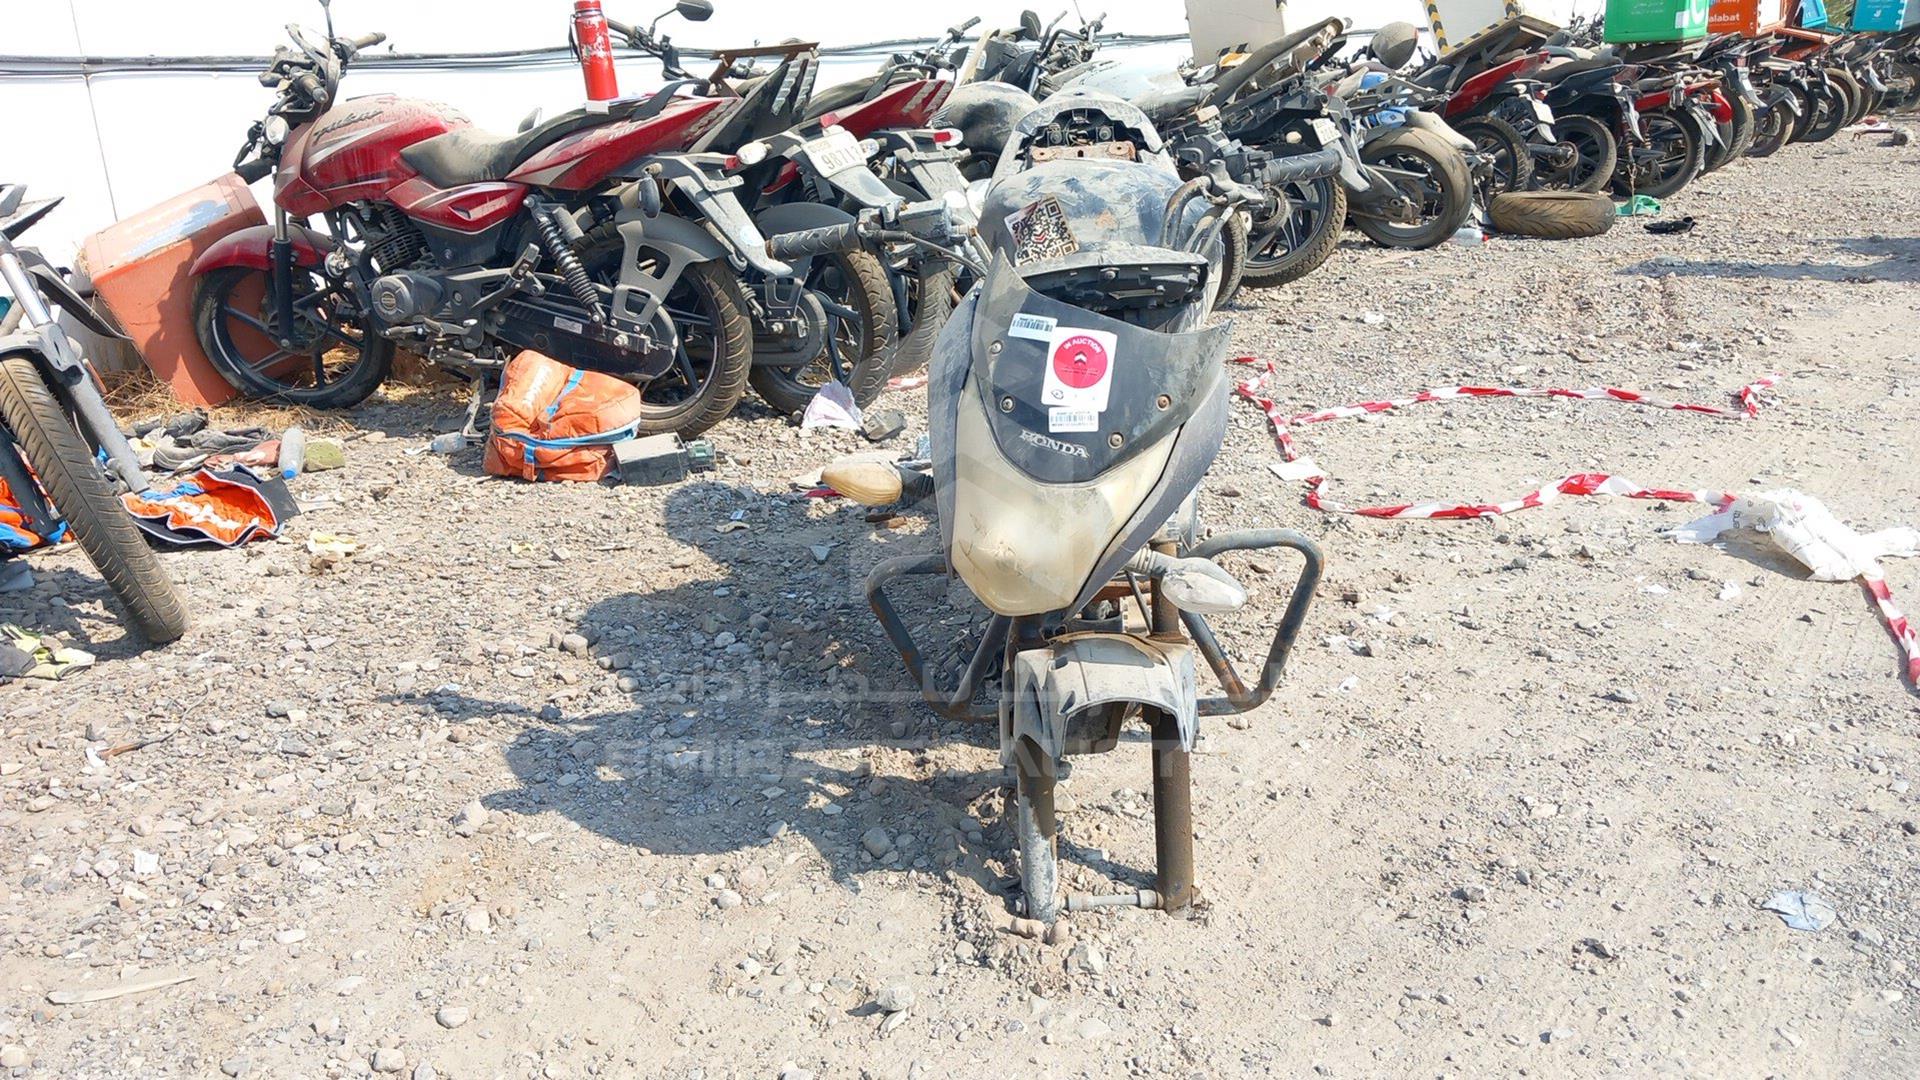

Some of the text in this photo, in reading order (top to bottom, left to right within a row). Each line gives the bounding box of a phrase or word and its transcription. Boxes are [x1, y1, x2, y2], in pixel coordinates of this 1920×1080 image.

[1708, 12, 1740, 23] alabat
[1063, 338, 1103, 353] IN AUCTION
[1019, 429, 1091, 458] HONDA
